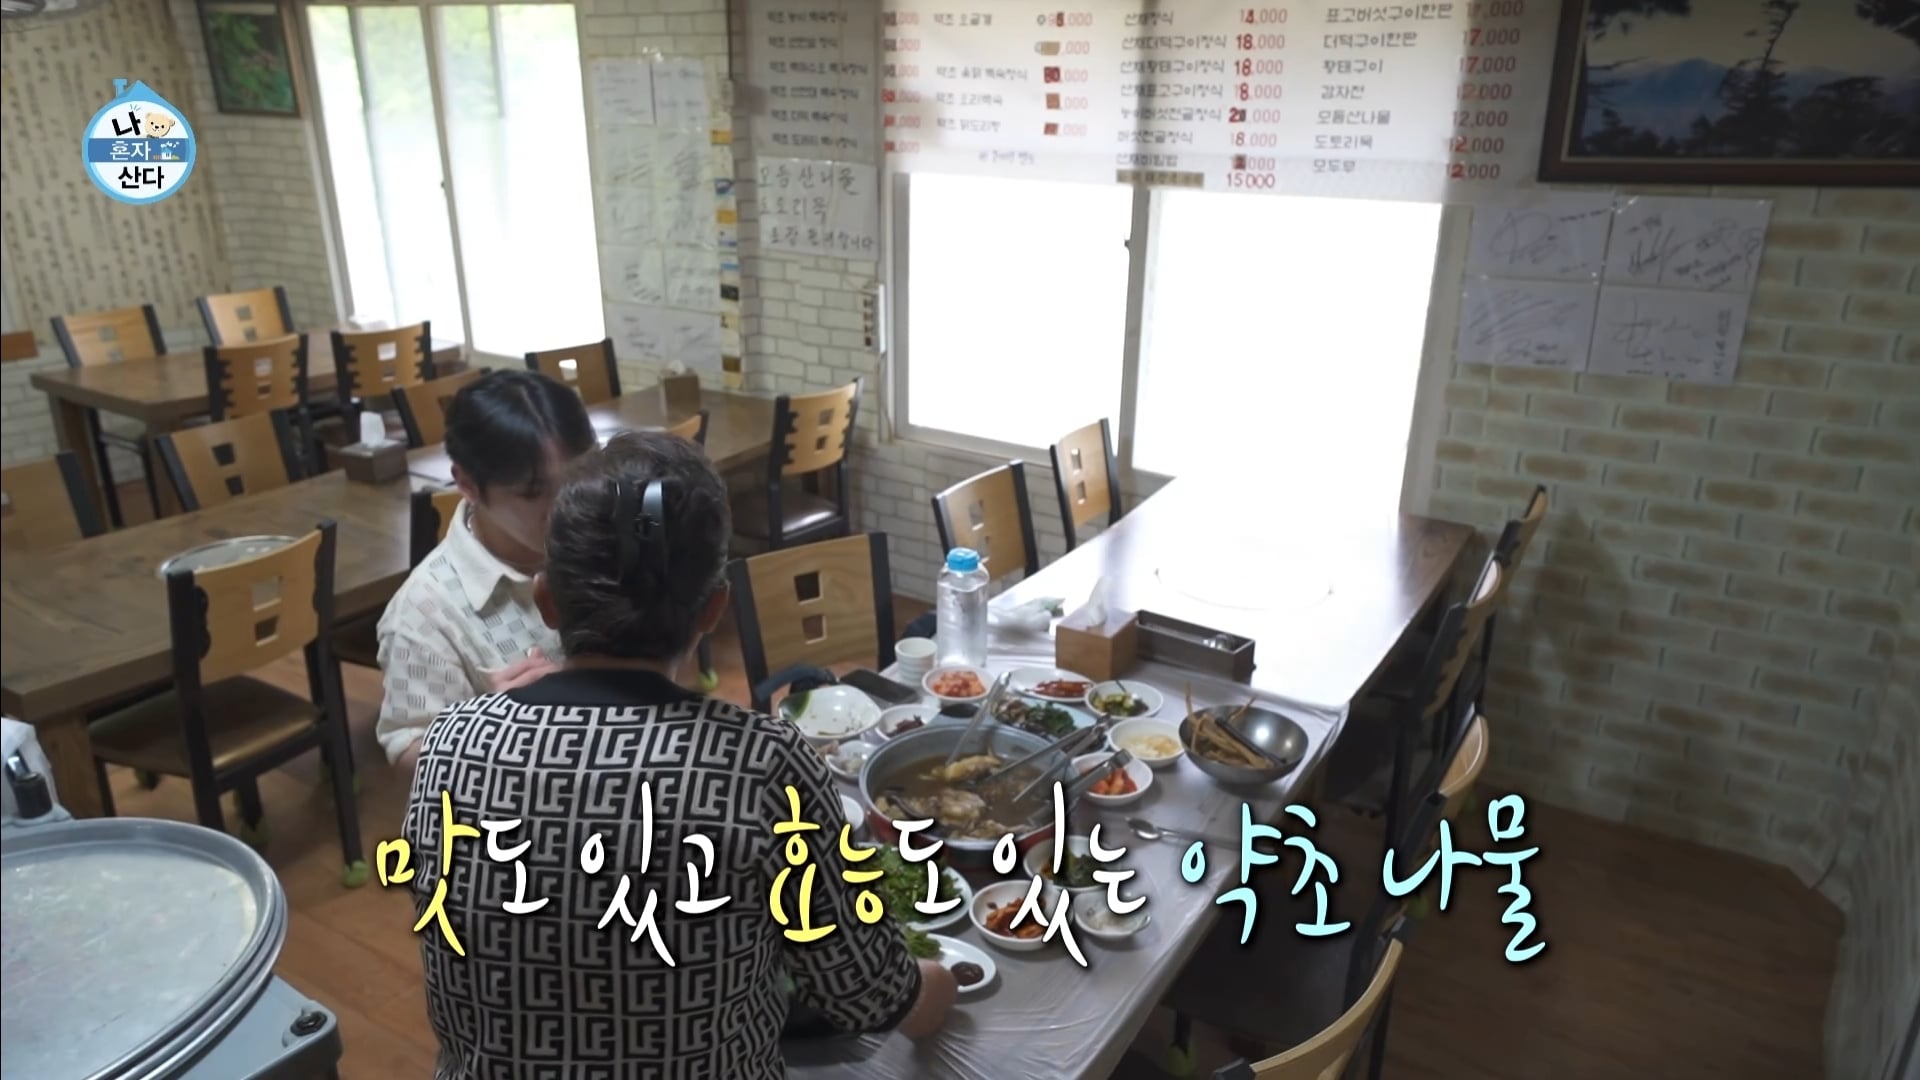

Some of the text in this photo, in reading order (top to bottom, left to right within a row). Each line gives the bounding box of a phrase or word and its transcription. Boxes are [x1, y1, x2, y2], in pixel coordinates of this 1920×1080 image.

[1325, 4, 1454, 24] 표고버섯구이한판
[1323, 32, 1418, 48] 더덕구이한판
[1321, 59, 1383, 75] 황태구이
[1321, 85, 1365, 100] 감자전
[1314, 134, 1373, 150] 도토리묵
[1312, 159, 1356, 173] 모두부
